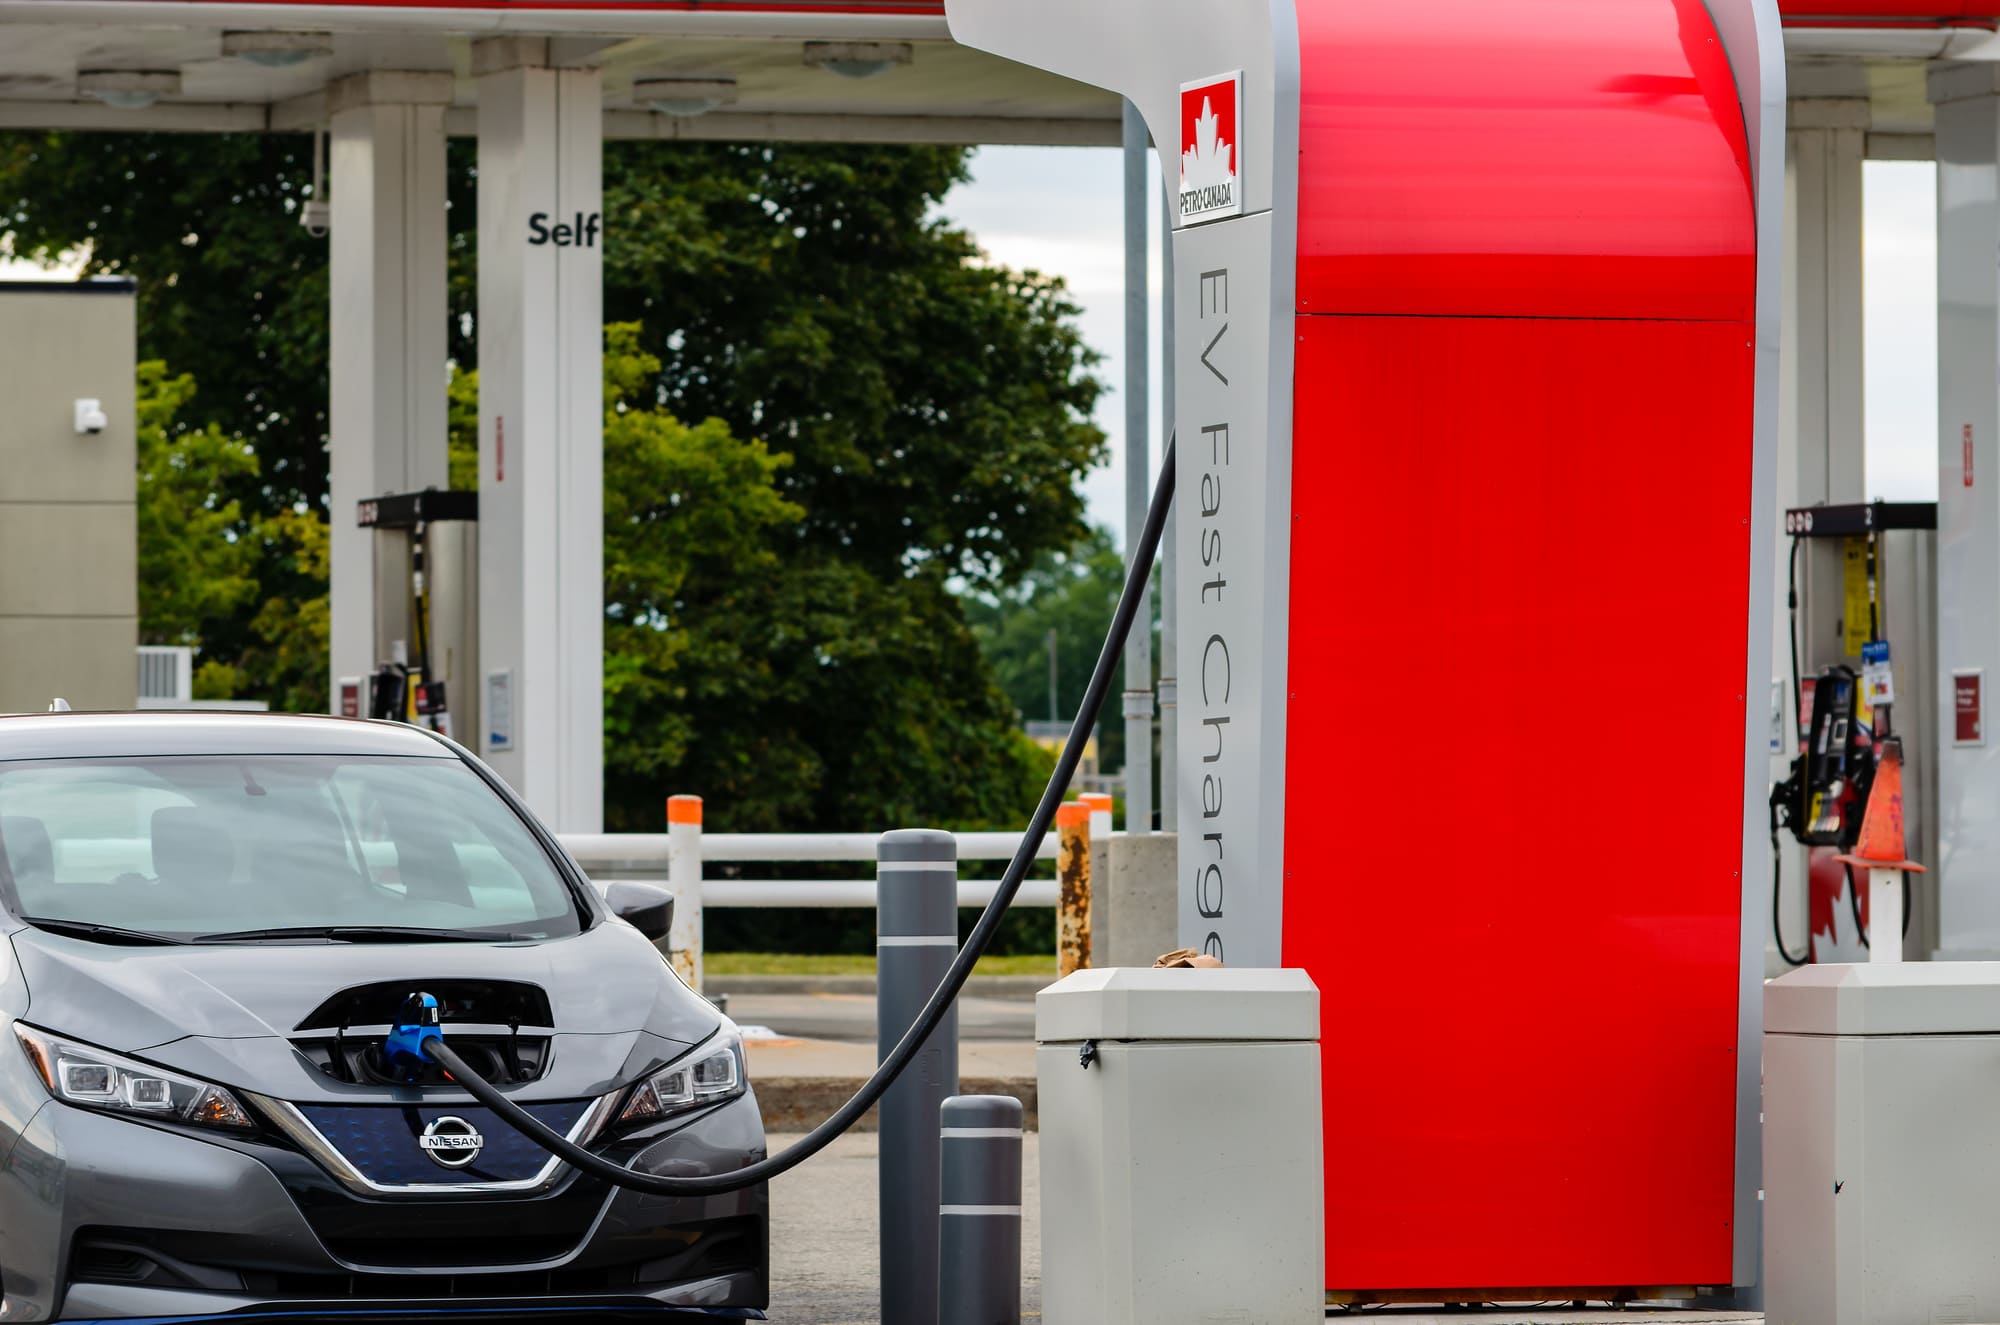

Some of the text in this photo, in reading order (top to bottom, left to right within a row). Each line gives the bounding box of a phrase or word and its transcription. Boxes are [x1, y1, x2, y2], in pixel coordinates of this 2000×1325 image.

[528, 212, 600, 247] Self
[1200, 268, 1229, 386] EV
[1201, 422, 1229, 604] Fast
[428, 1137, 478, 1146] NISSAN
